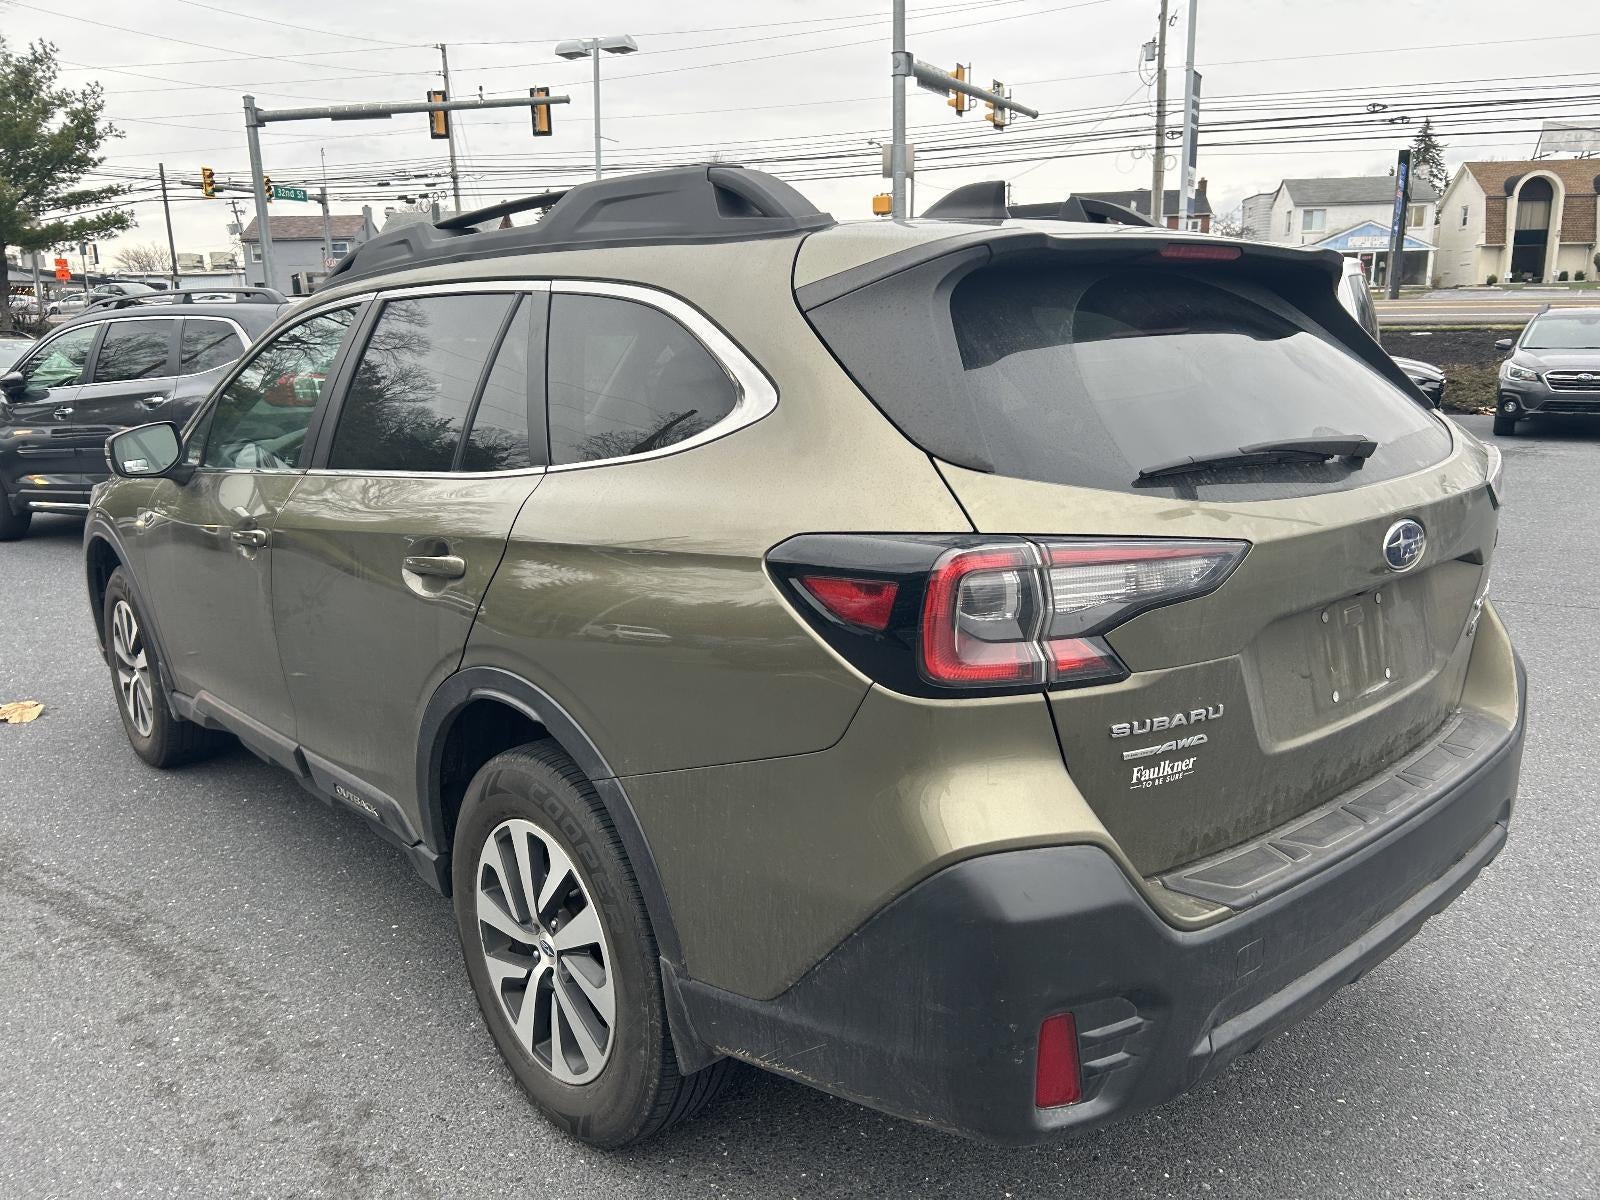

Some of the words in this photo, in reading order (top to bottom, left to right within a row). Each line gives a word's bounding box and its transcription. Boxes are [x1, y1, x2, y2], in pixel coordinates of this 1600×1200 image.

[277, 188, 295, 198] 32nd
[296, 190, 304, 199] St
[1110, 703, 1224, 739] SUBARU
[1156, 733, 1208, 755] AWD
[1130, 756, 1197, 784] Faulkner
[1142, 780, 1153, 789] TO
[1154, 777, 1163, 786] BE
[1165, 772, 1184, 784] SURE
[335, 784, 379, 817] OUTBACK
